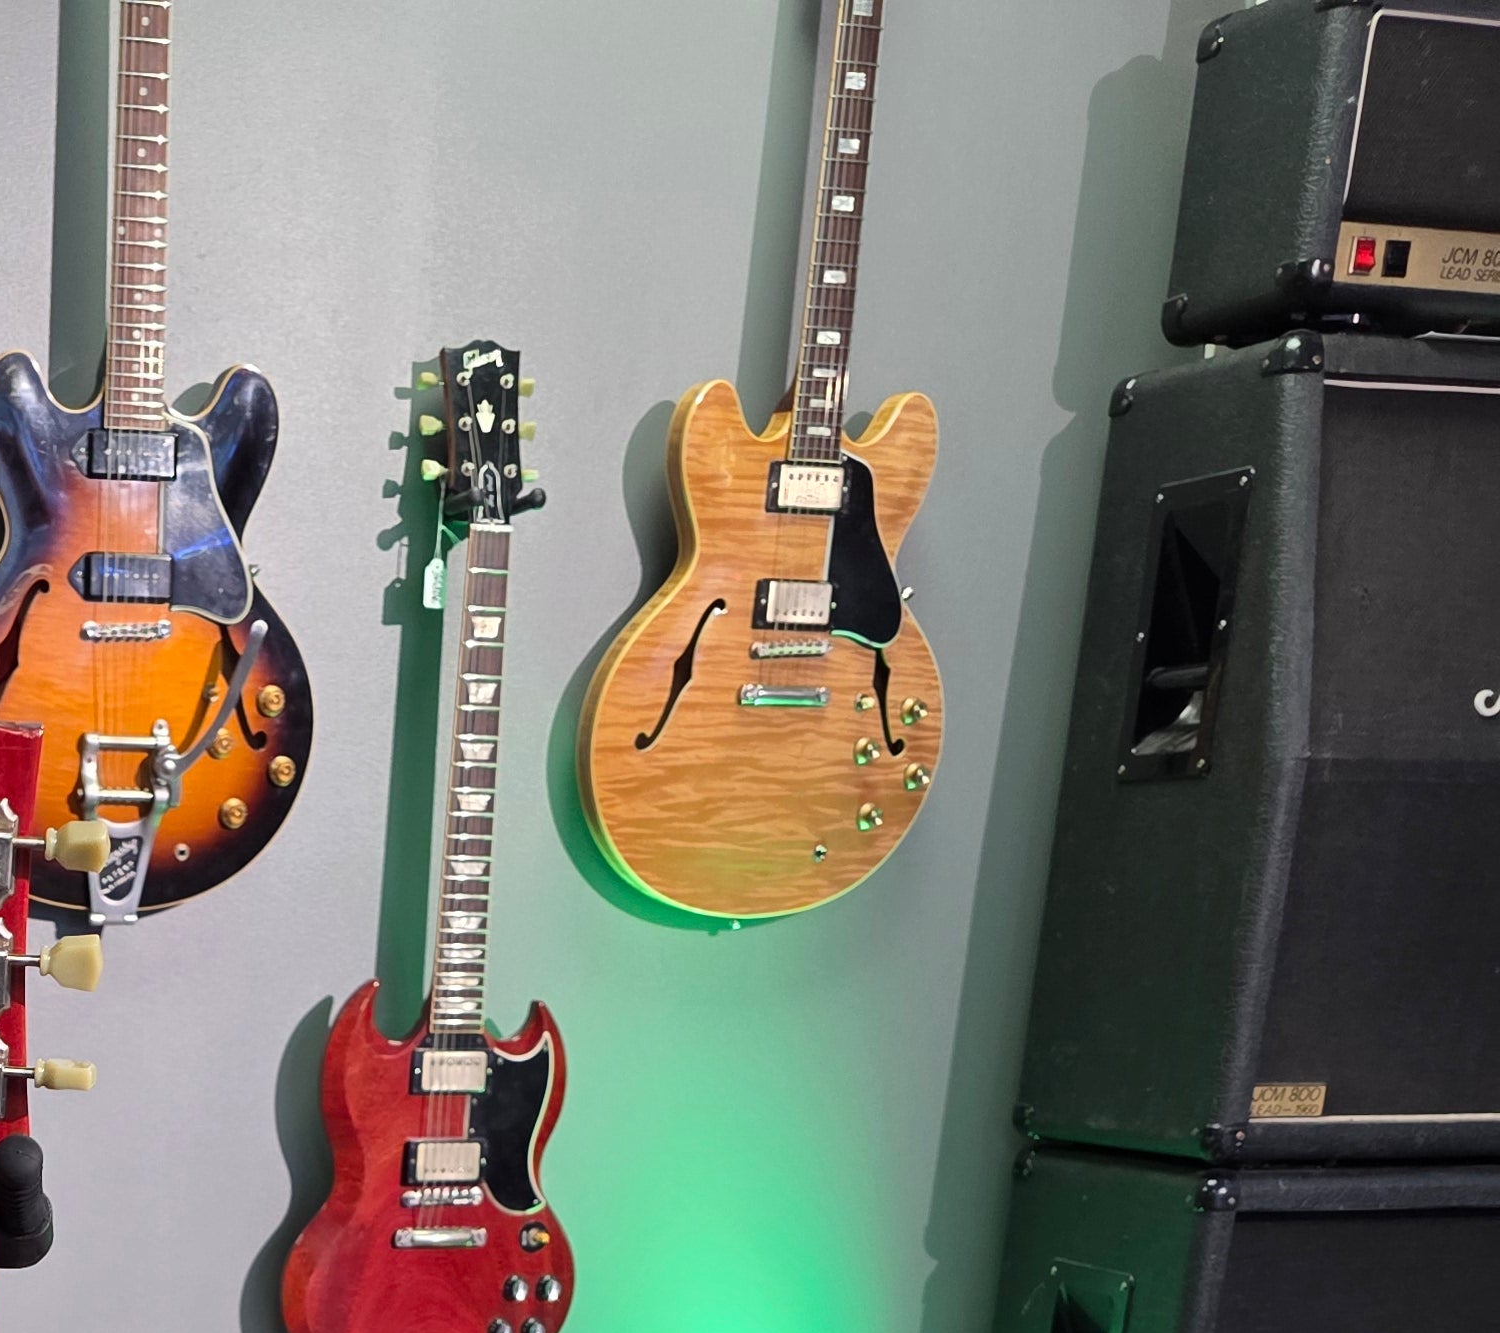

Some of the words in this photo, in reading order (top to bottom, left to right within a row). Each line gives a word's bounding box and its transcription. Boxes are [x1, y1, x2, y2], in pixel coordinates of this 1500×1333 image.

[1441, 247, 1479, 266] JCM
[1440, 265, 1472, 281] LEAD
[1289, 1086, 1322, 1102] 800
